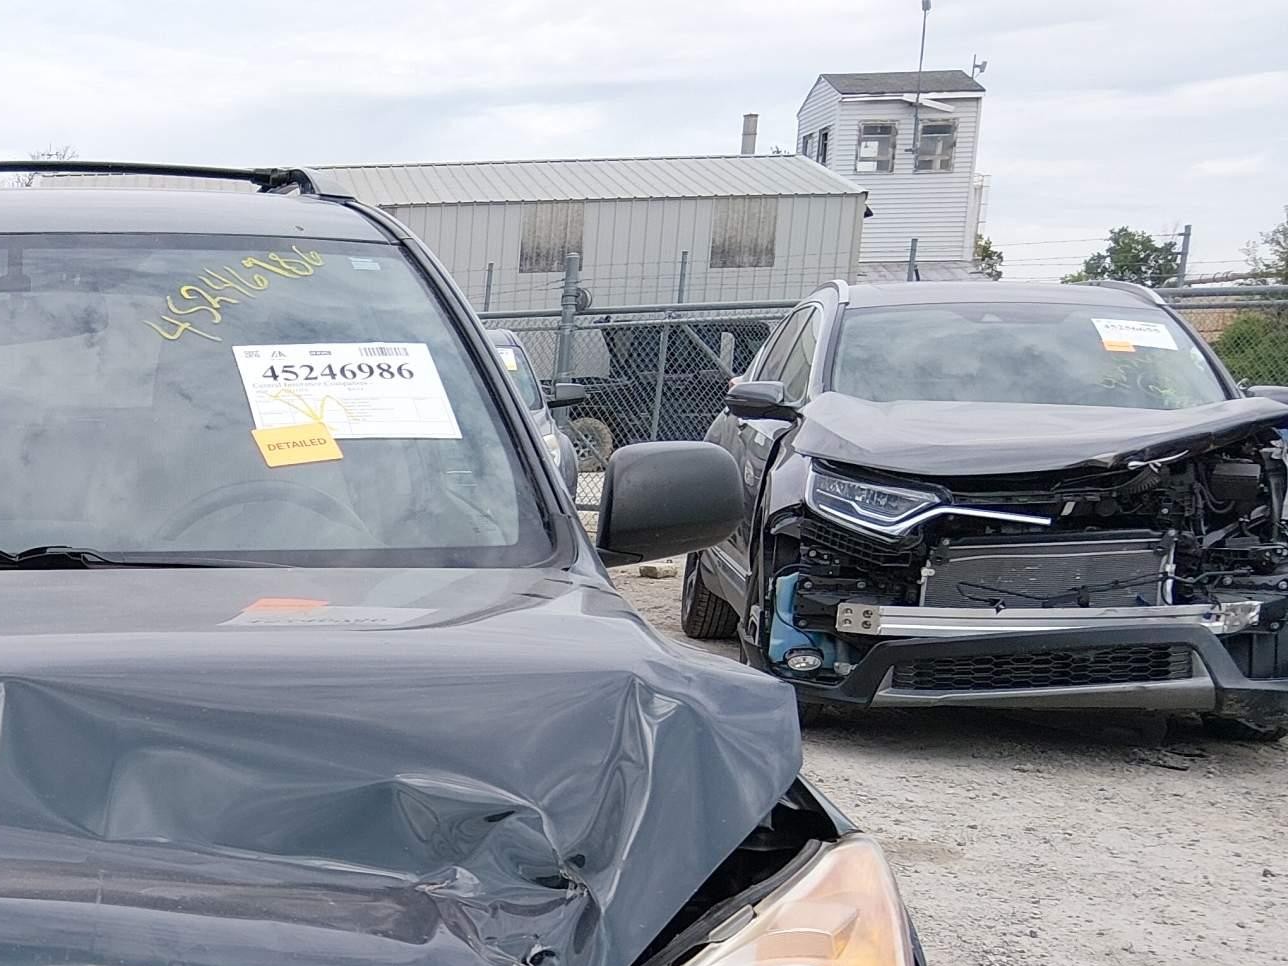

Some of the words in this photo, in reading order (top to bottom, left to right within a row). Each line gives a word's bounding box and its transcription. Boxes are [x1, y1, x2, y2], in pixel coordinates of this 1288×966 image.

[143, 244, 326, 342] 45246986
[262, 362, 415, 382] 45246986
[267, 437, 327, 452] DETAILED
